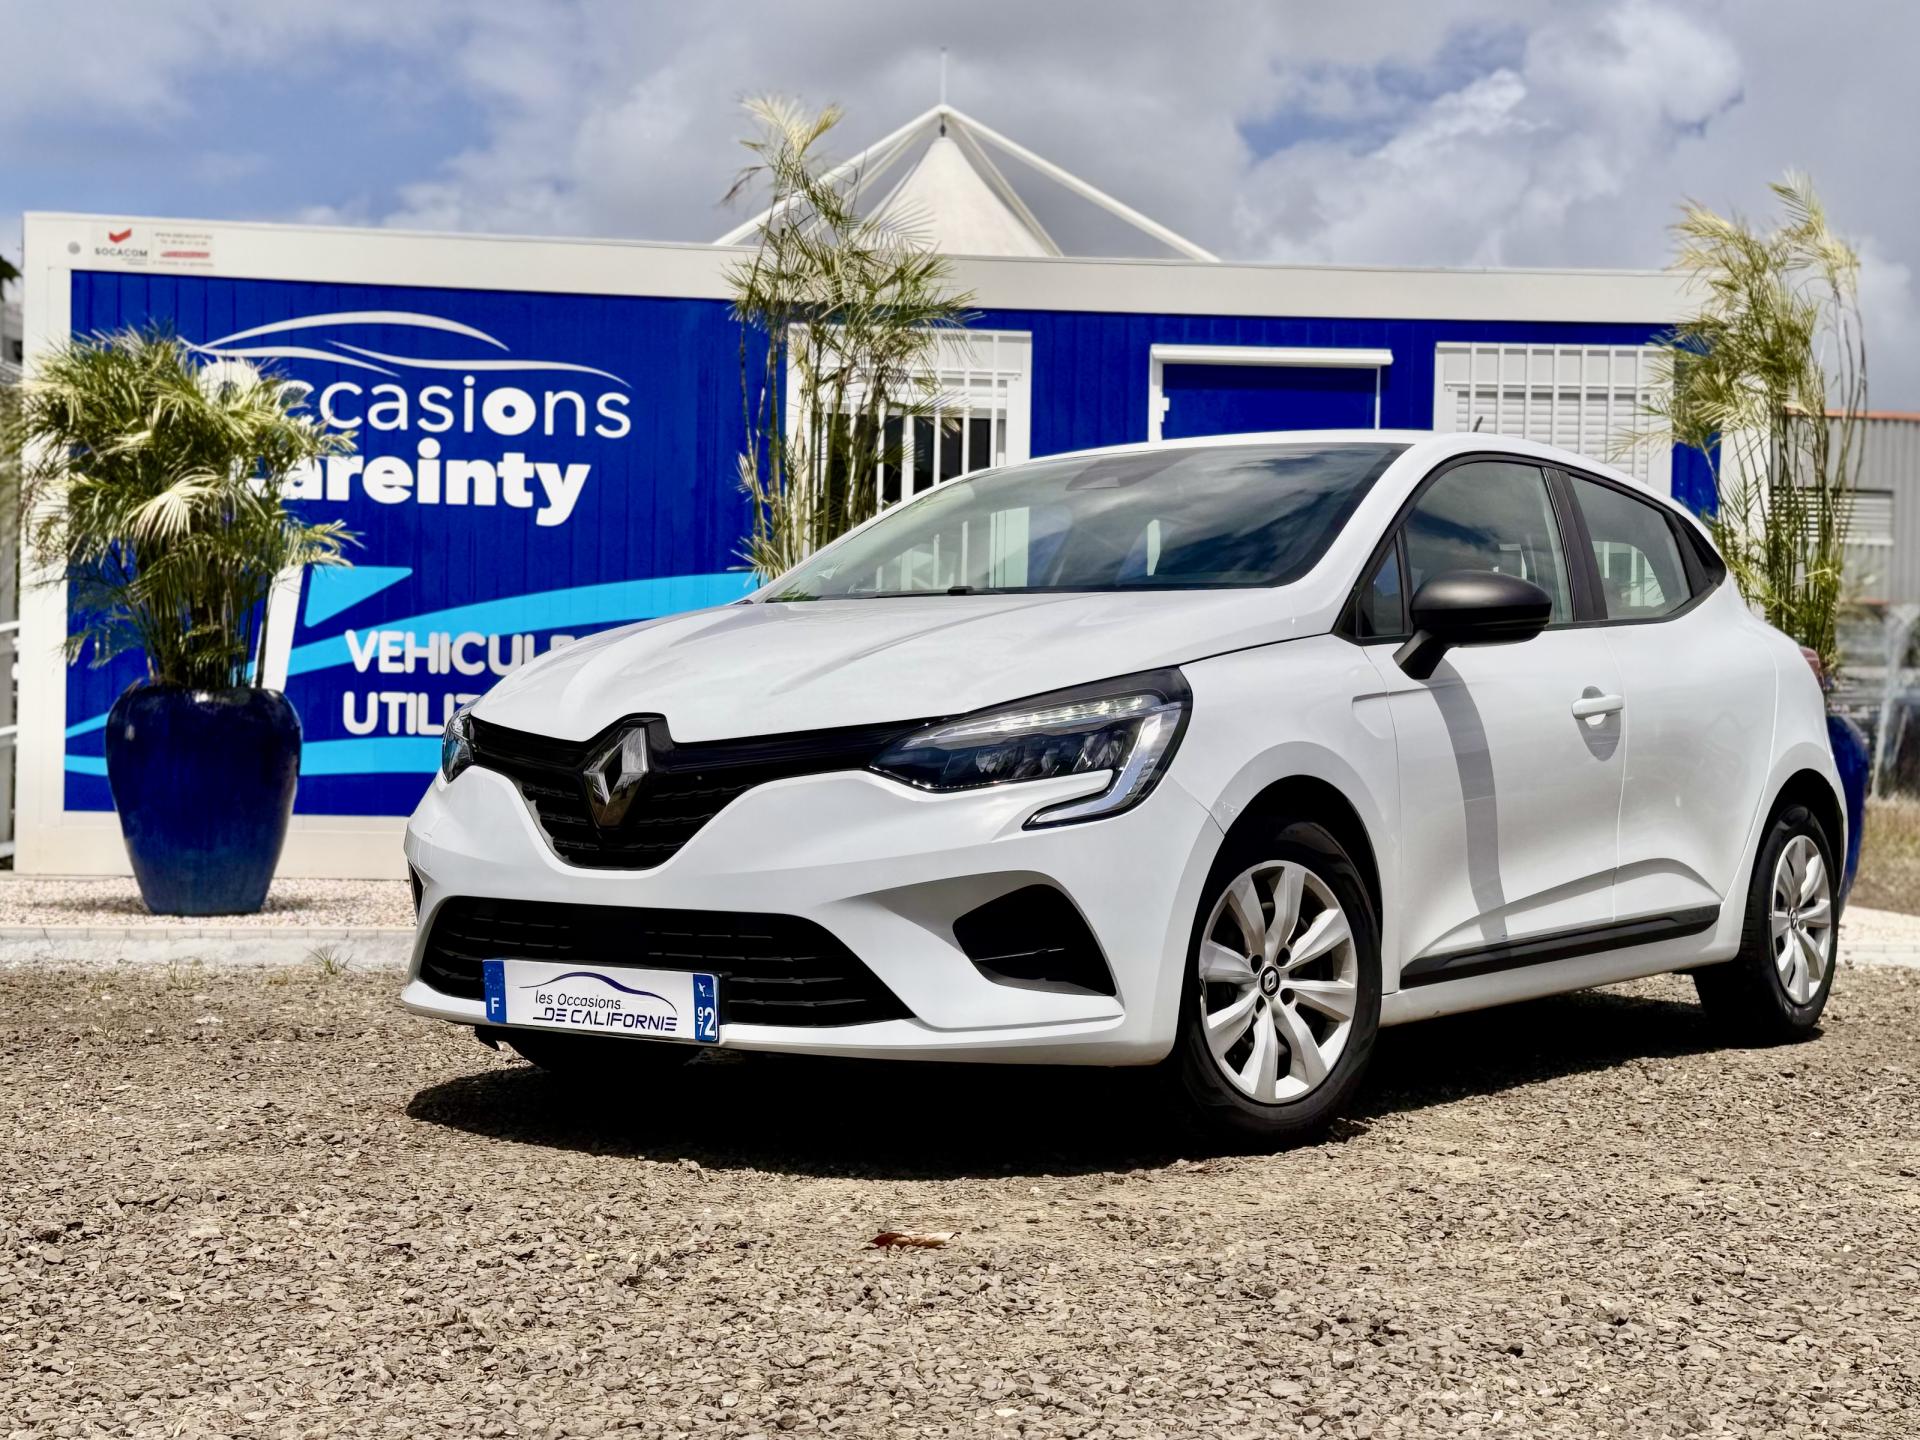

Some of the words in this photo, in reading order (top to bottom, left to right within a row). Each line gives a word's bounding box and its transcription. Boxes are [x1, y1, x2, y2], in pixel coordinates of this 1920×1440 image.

[95, 247, 148, 257] SOCACOM
[344, 629, 575, 676] VEHICU
[342, 690, 481, 736] UTILI
[491, 997, 499, 1014] F
[535, 989, 553, 1005] les
[557, 993, 621, 1010] Occasions
[533, 1007, 567, 1022] DE
[570, 1009, 678, 1032] CALIFORNIE
